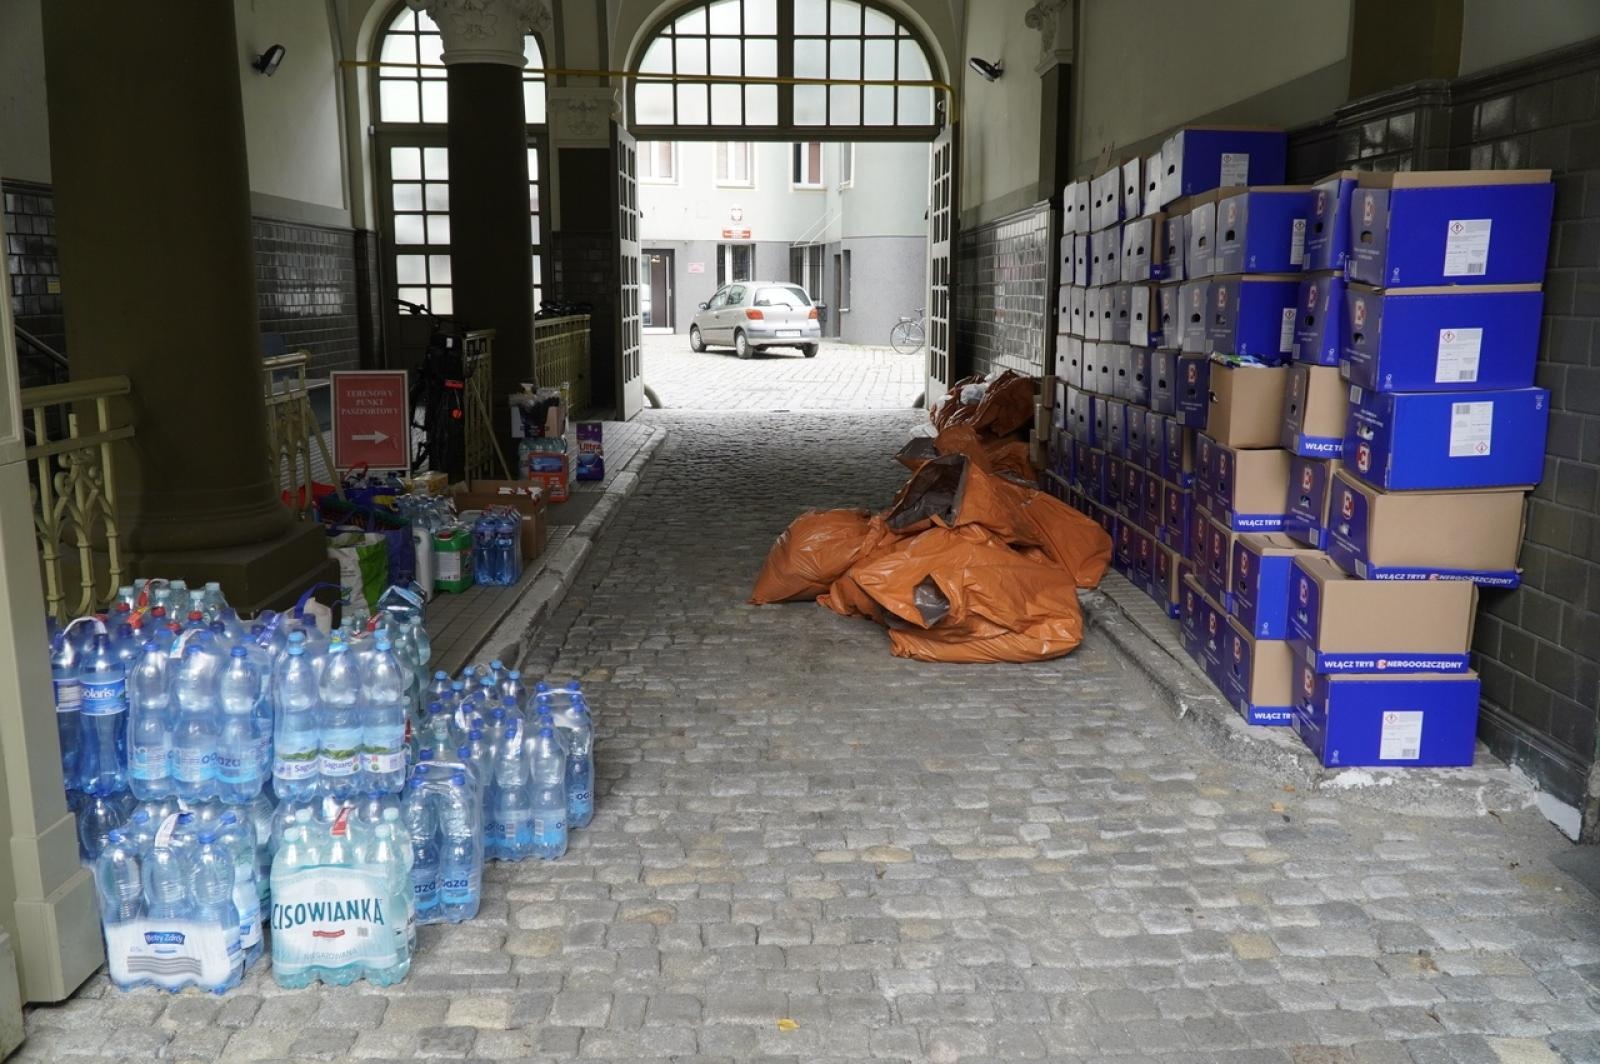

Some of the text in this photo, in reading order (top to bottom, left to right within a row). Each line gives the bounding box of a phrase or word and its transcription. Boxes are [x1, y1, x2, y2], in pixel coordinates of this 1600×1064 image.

[345, 390, 394, 398] TERENOWY
[341, 407, 398, 416] PASZPORTOWY
[1324, 661, 1354, 669] WŁĄCZ
[1354, 660, 1375, 668] TRYB
[82, 687, 113, 699] olaris
[1254, 712, 1281, 720] WŁĄCZ
[272, 898, 385, 930] CISOWIANKA
